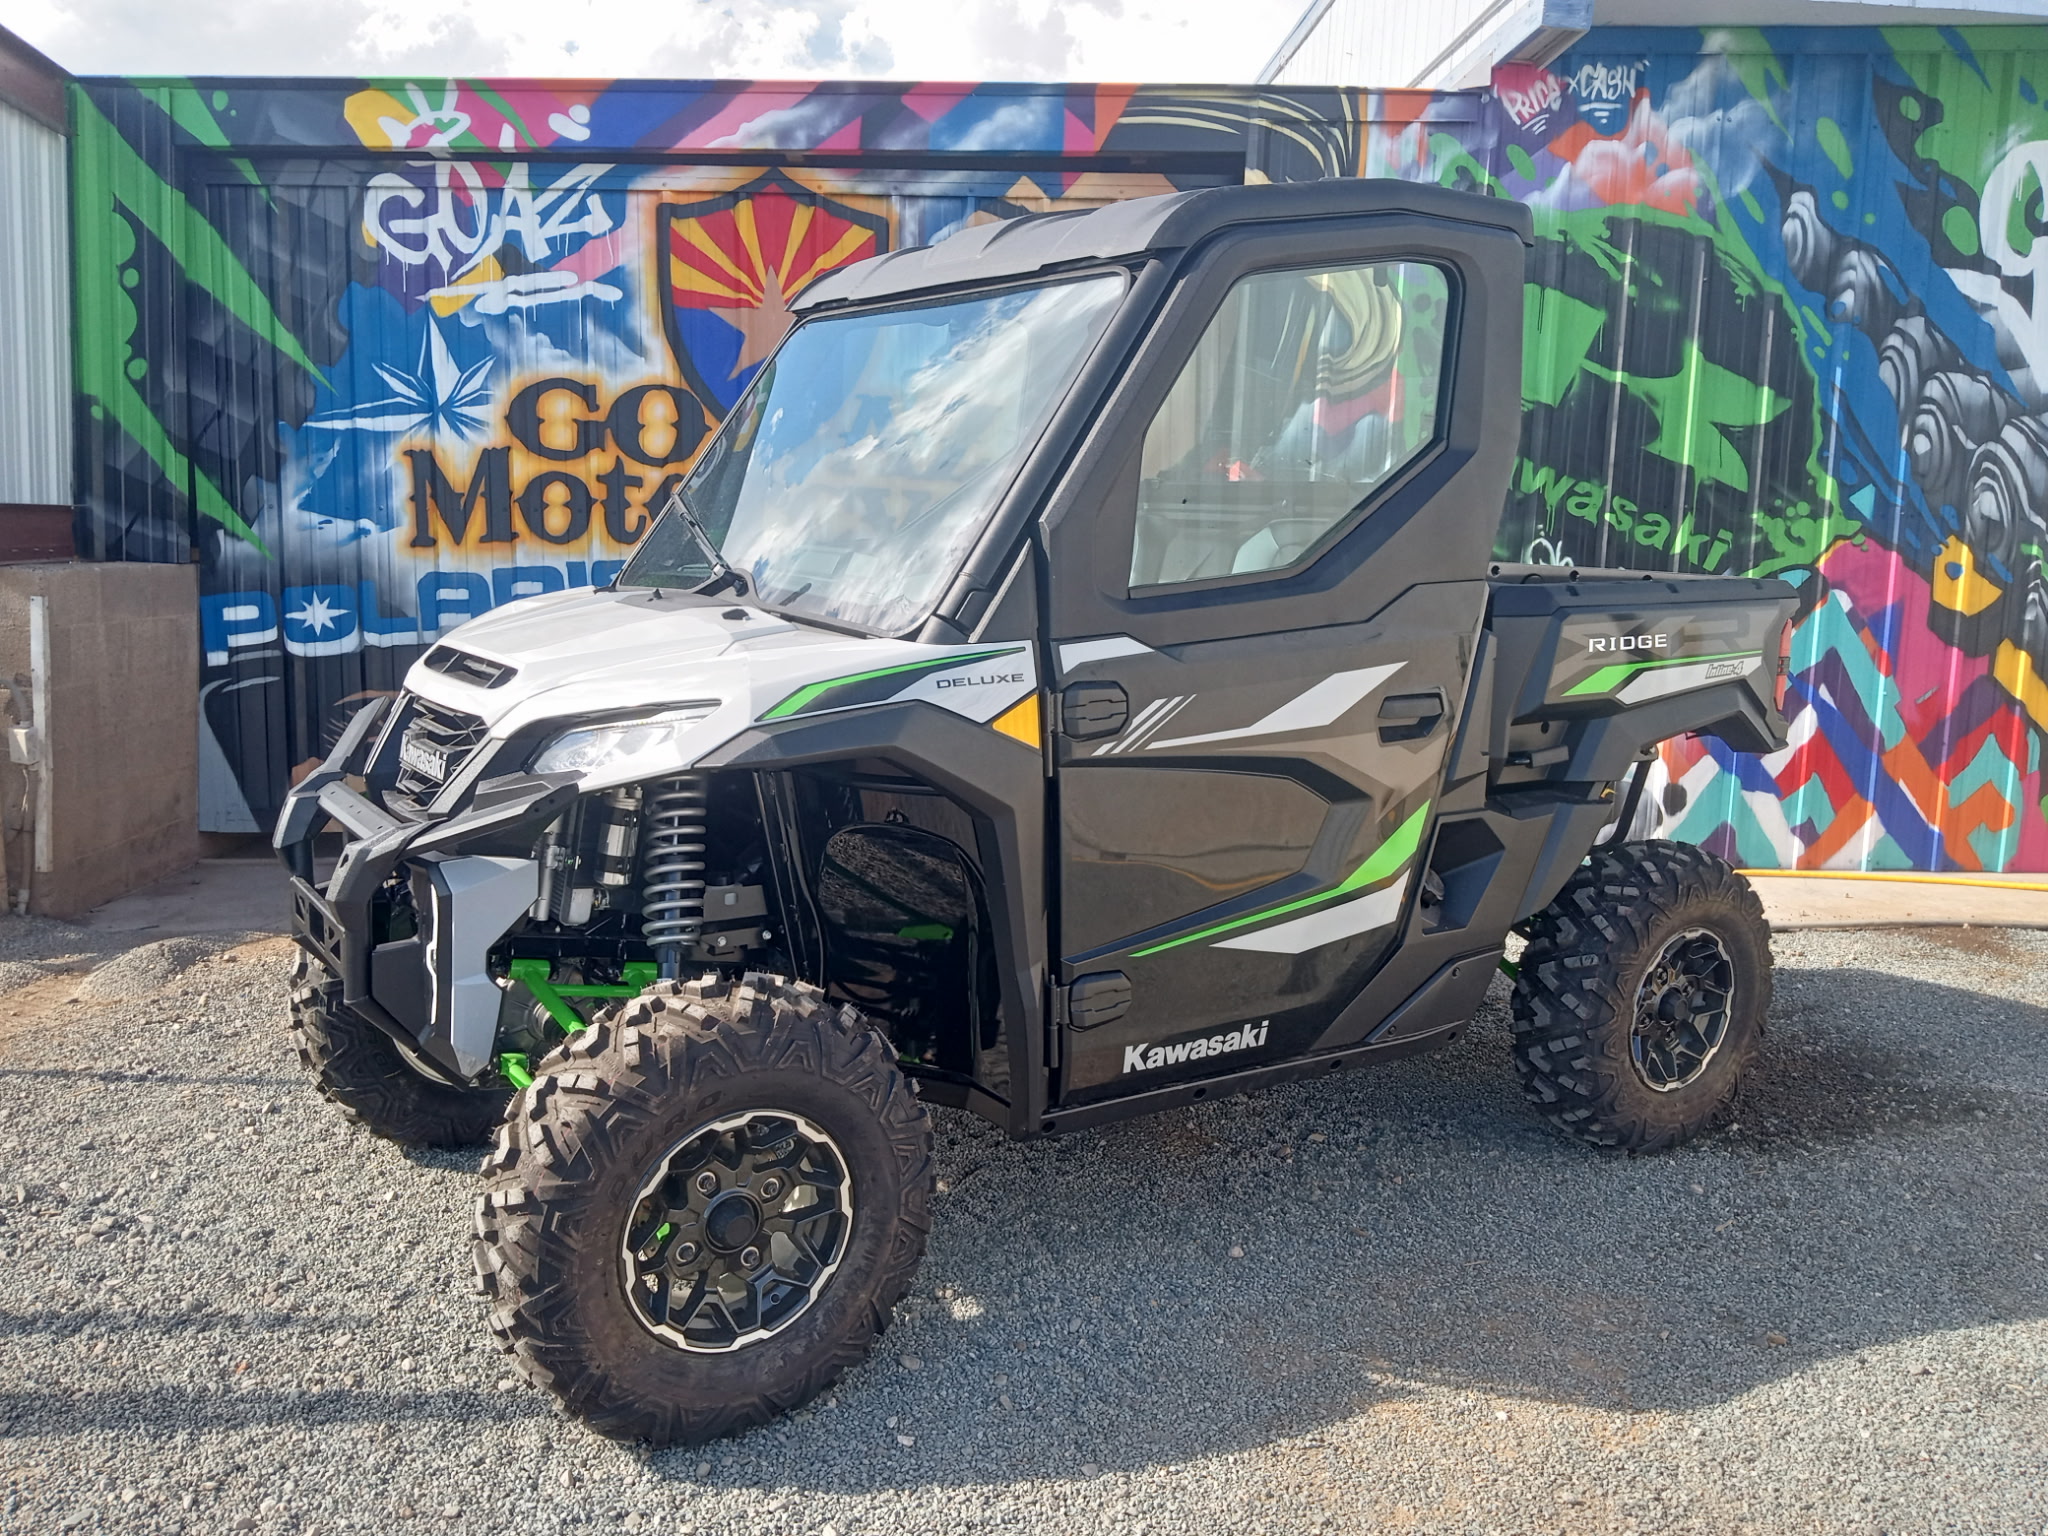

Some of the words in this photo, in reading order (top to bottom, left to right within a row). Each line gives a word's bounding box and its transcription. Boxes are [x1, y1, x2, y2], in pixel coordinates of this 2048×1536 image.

[504, 377, 713, 468] GO
[1509, 455, 1734, 573] wasaki
[1588, 633, 1668, 653] RIDGE
[936, 673, 1025, 689] DELUXE
[1122, 1020, 1270, 1074] Kawasaki
